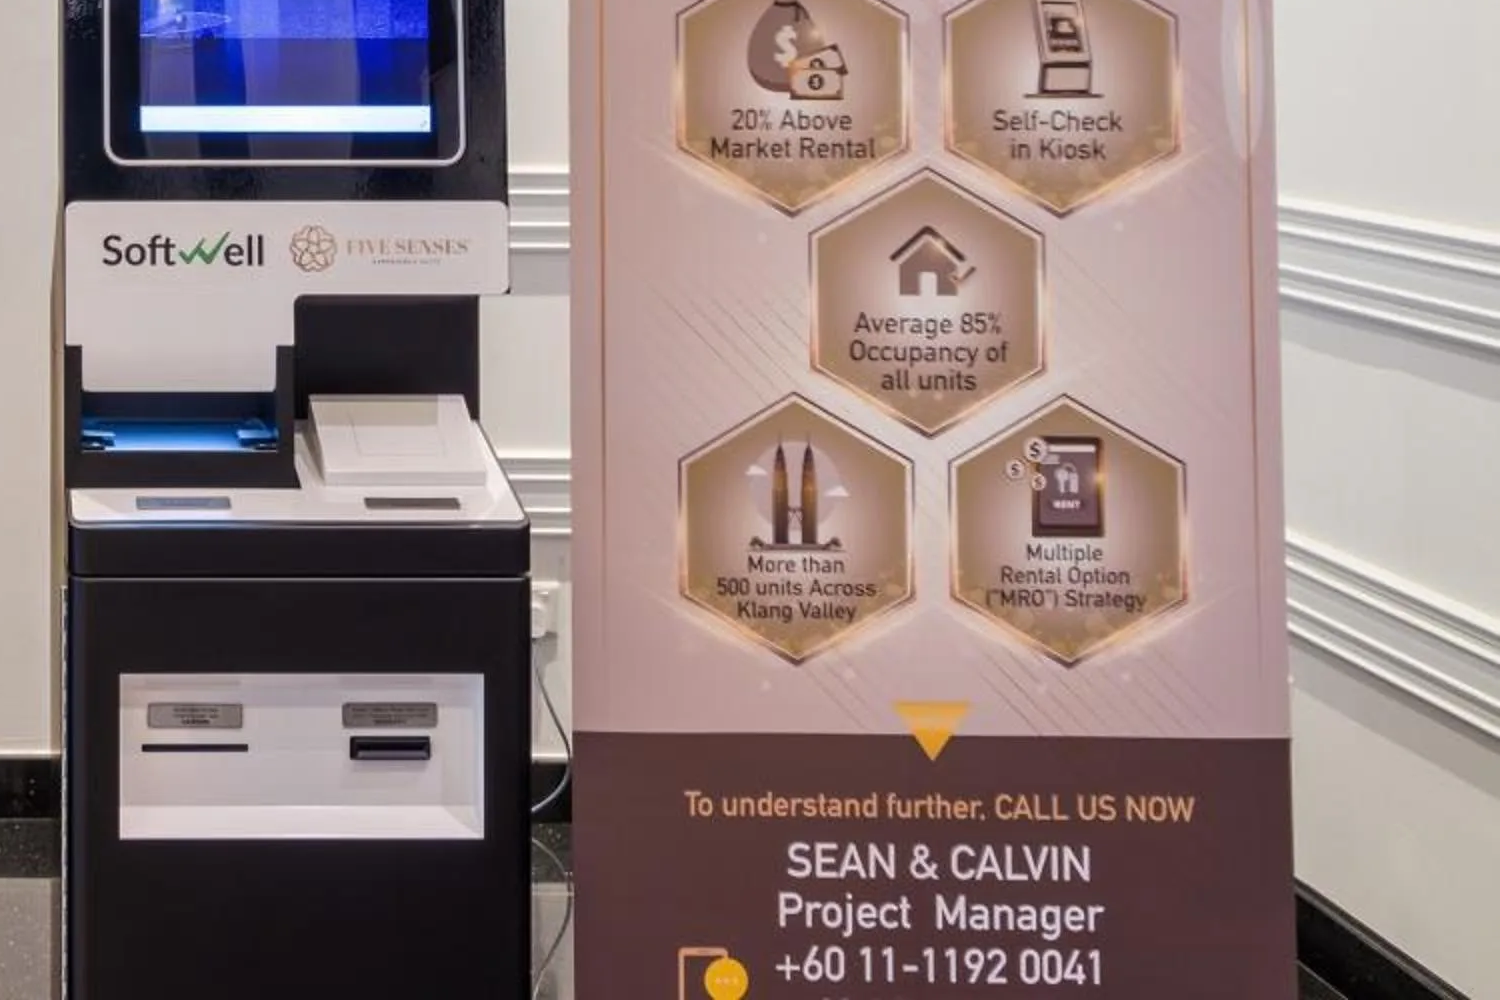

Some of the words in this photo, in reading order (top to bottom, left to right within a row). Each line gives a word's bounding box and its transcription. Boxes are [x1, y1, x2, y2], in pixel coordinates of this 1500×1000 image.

[731, 109, 772, 131] 20%
[780, 109, 853, 131] Above
[992, 109, 1124, 132] Self-Check
[711, 138, 791, 160] Market
[799, 138, 876, 160] Rental
[1010, 138, 1031, 161] in
[1040, 138, 1107, 161] Kiosk
[102, 231, 264, 266] SoftWell
[347, 240, 388, 256] FIVE
[854, 313, 952, 340] Average
[961, 313, 1002, 336] 85%
[849, 341, 978, 368] Occupancy
[986, 341, 1009, 364] of
[880, 370, 912, 392] all
[919, 370, 977, 392] units
[1026, 543, 1104, 564] Multiple
[747, 555, 794, 575] More
[802, 555, 845, 575] than
[1001, 566, 1061, 585] Rental
[1068, 567, 1130, 588] Option
[716, 579, 748, 598] 500
[754, 579, 803, 598] units
[808, 579, 876, 598] Across
[1064, 590, 1147, 612] Strategy
[737, 602, 794, 624] Klang
[800, 602, 856, 624] Valley
[684, 790, 713, 817] To
[722, 792, 878, 818] understand
[995, 795, 1069, 821] CALL
[1077, 796, 1117, 822] US
[1126, 796, 1195, 823] NOW
[787, 844, 896, 880] SEAN
[909, 844, 939, 881] &
[949, 845, 1092, 882] CALVIN
[778, 892, 912, 937] Project
[935, 896, 1105, 941] Manager
[775, 946, 845, 982] +60
[861, 948, 1007, 984] 11-1192
[1019, 950, 1102, 985] 0041
